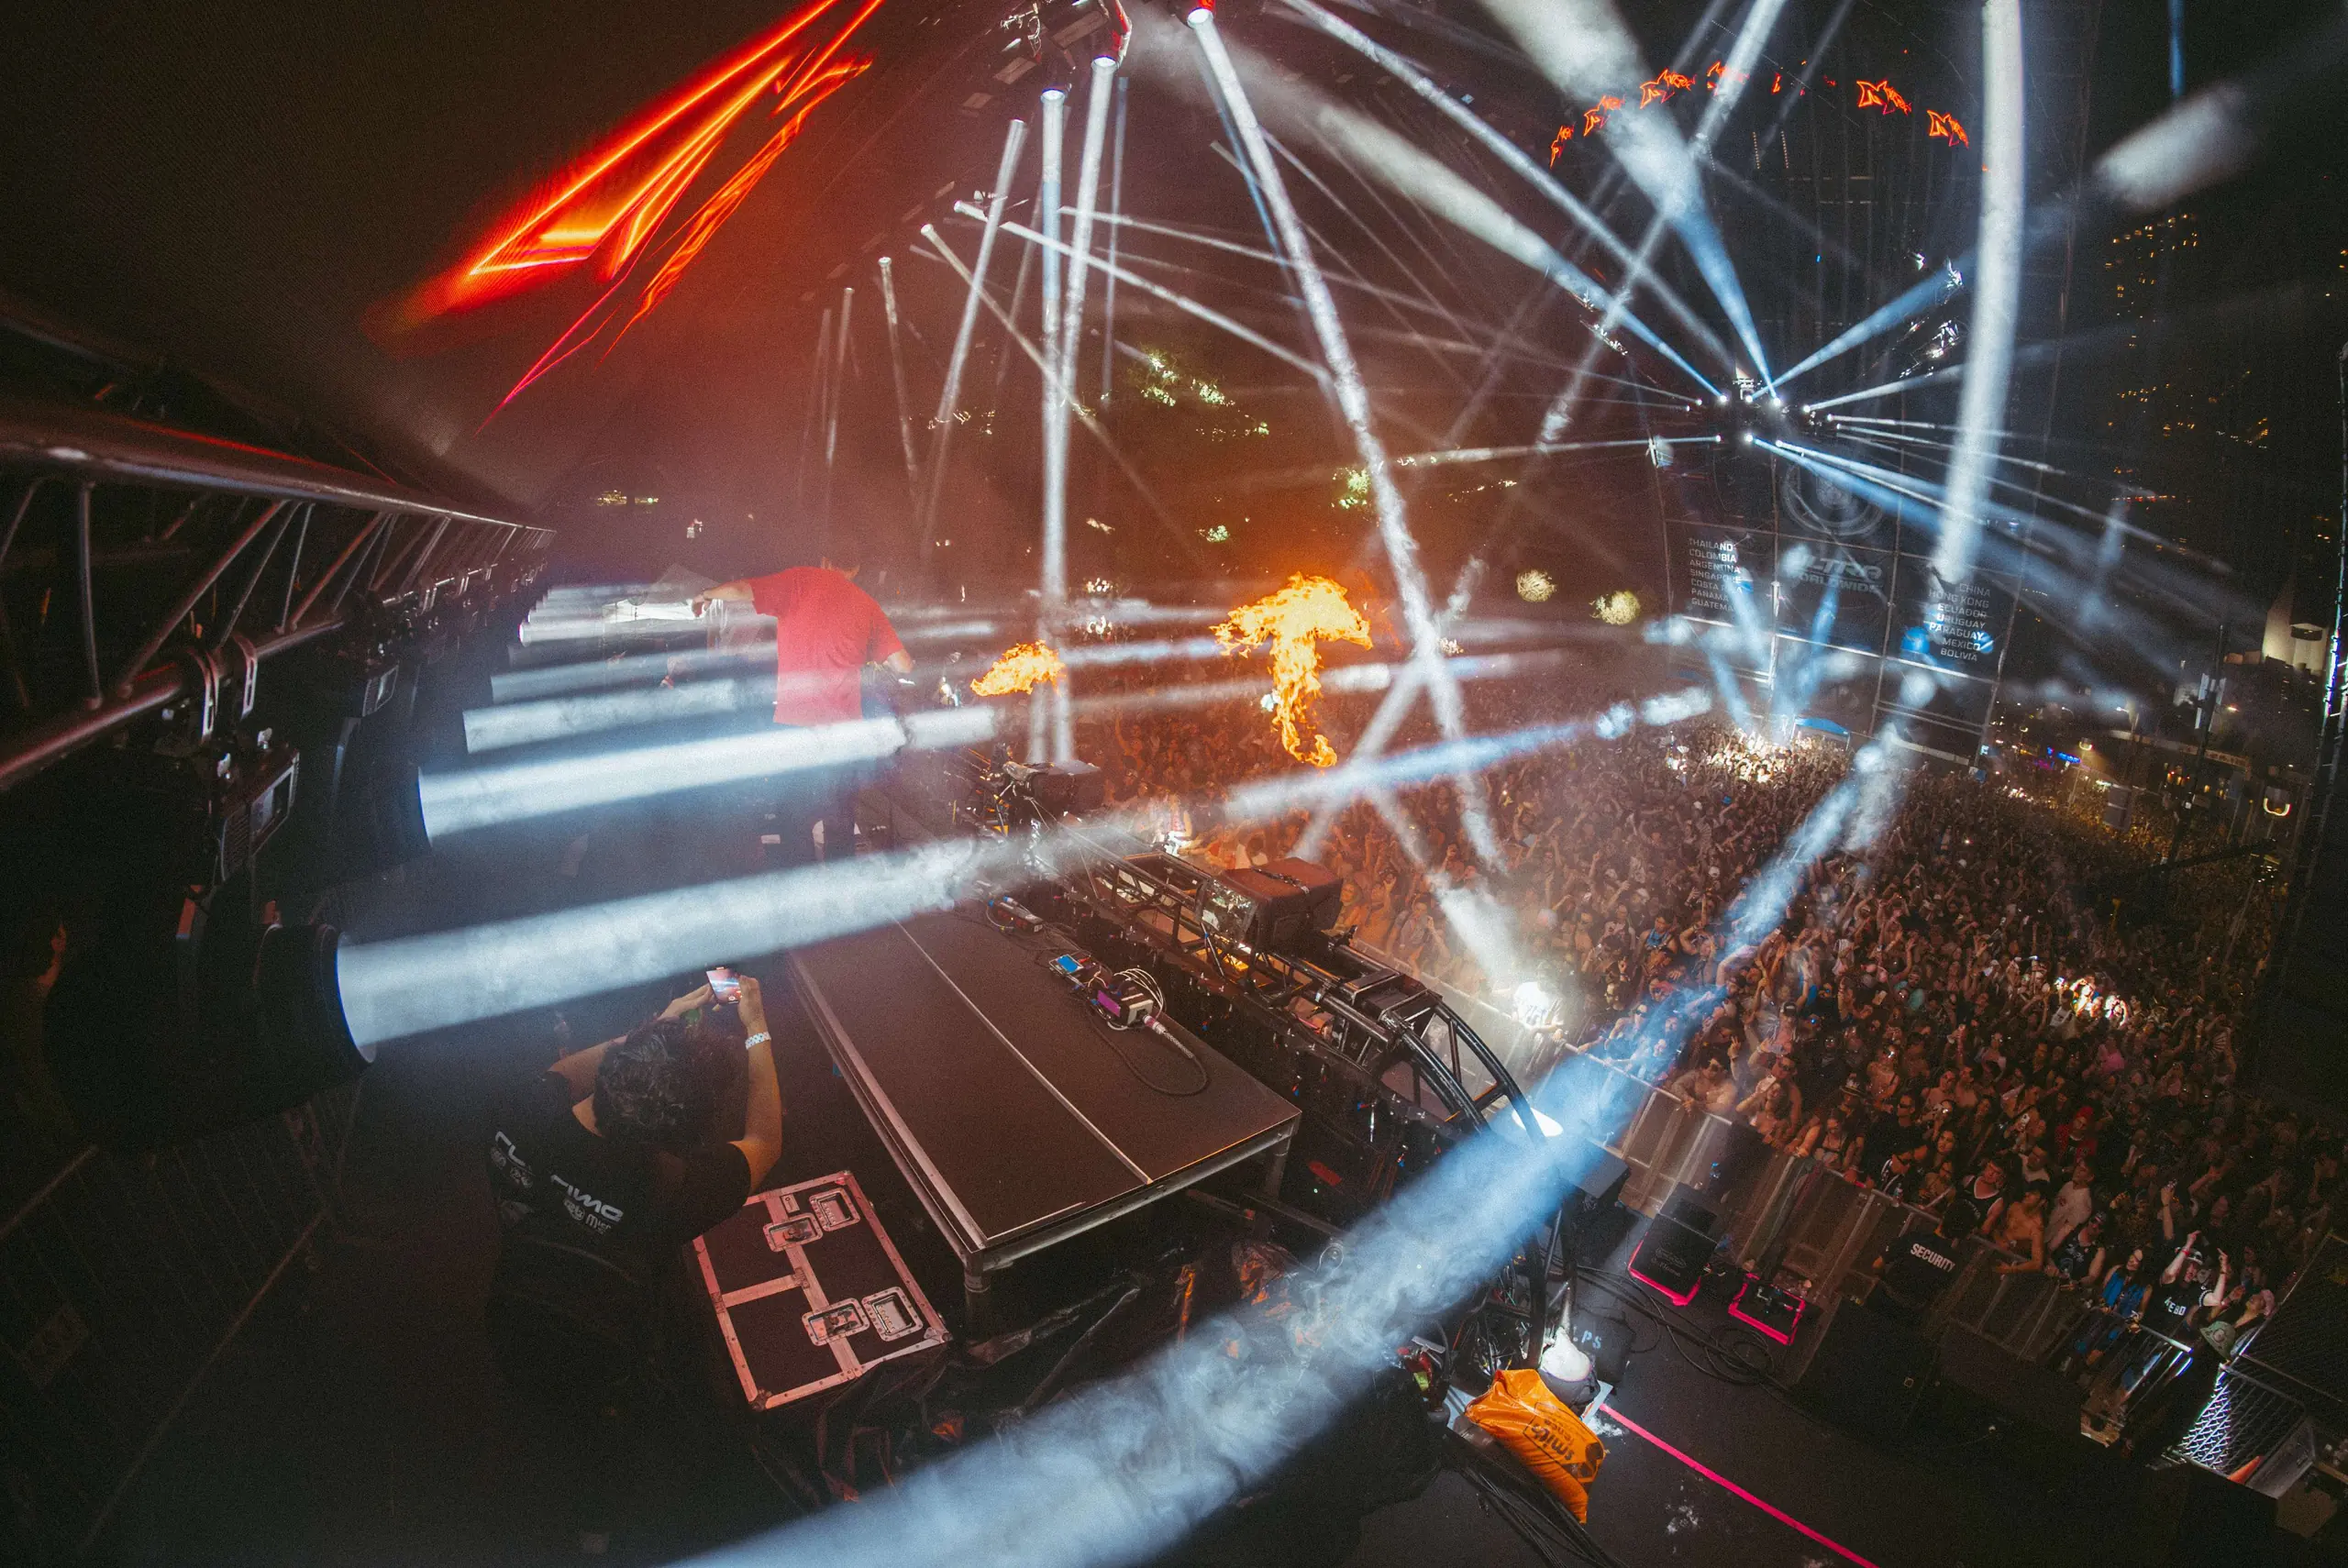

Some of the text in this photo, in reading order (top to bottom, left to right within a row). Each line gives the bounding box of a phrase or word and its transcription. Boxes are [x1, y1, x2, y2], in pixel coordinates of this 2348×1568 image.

[1689, 537, 1733, 552] THAILAND
[1689, 548, 1737, 563] COLOMBIA
[1689, 559, 1742, 574] ARGENTINA
[1690, 579, 1719, 591] COSTA
[1959, 582, 1991, 597] CHINA
[1691, 588, 1729, 602] PANAMA
[1928, 588, 1989, 609] HONG KONG
[1937, 602, 1987, 619] ECUADOR
[1936, 613, 1986, 629] URUGUAY
[1929, 622, 1985, 641] PARAGUAY
[1943, 637, 1981, 652] MEXICO
[1940, 647, 1978, 661] BOLIVIA
[1910, 1242, 1956, 1273] SECURITY
